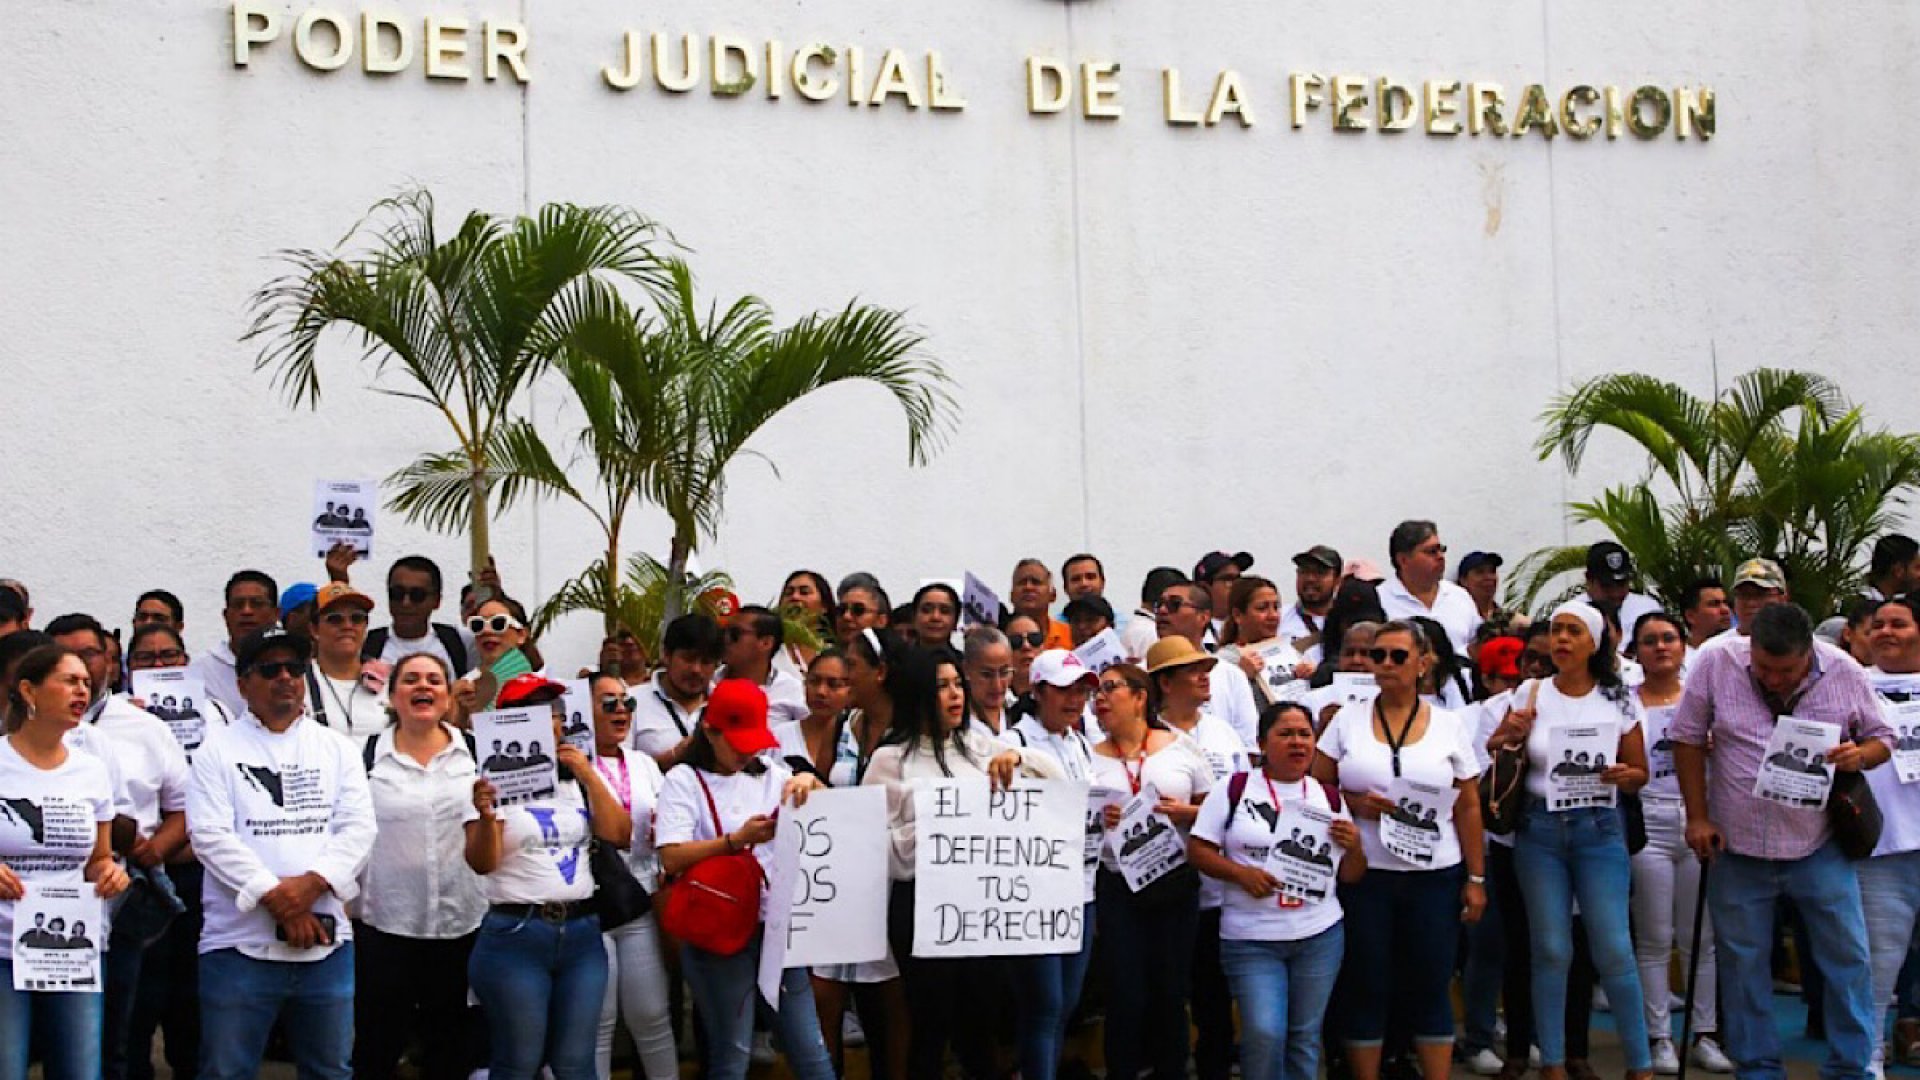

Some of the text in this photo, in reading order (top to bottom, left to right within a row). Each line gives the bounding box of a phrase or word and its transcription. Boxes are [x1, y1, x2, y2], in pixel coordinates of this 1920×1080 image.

[232, 2, 1716, 142] PODER JUDICIAL DE LA FEDERACION
[934, 786, 1044, 821] EL PJF
[928, 833, 1070, 870] DEFIENDE
[977, 875, 1030, 902] TUS
[933, 903, 1082, 946] DERECHOS
